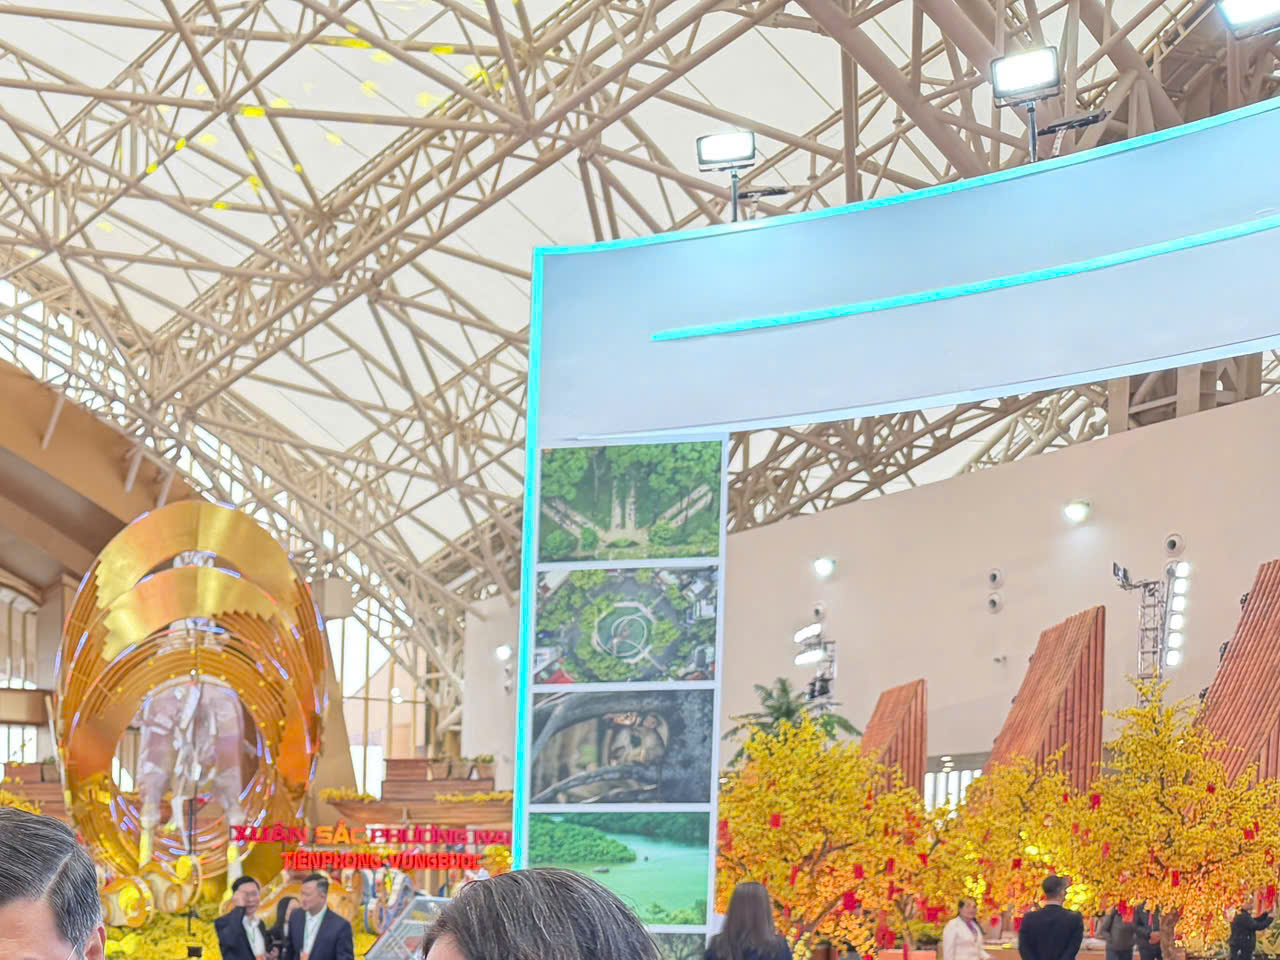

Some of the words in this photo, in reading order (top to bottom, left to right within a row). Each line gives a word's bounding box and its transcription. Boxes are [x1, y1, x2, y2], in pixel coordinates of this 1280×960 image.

[231, 821, 308, 843] XUÂN
[315, 817, 368, 844] SẮC
[372, 824, 468, 844] PHƯƠNG
[474, 828, 512, 845] NA
